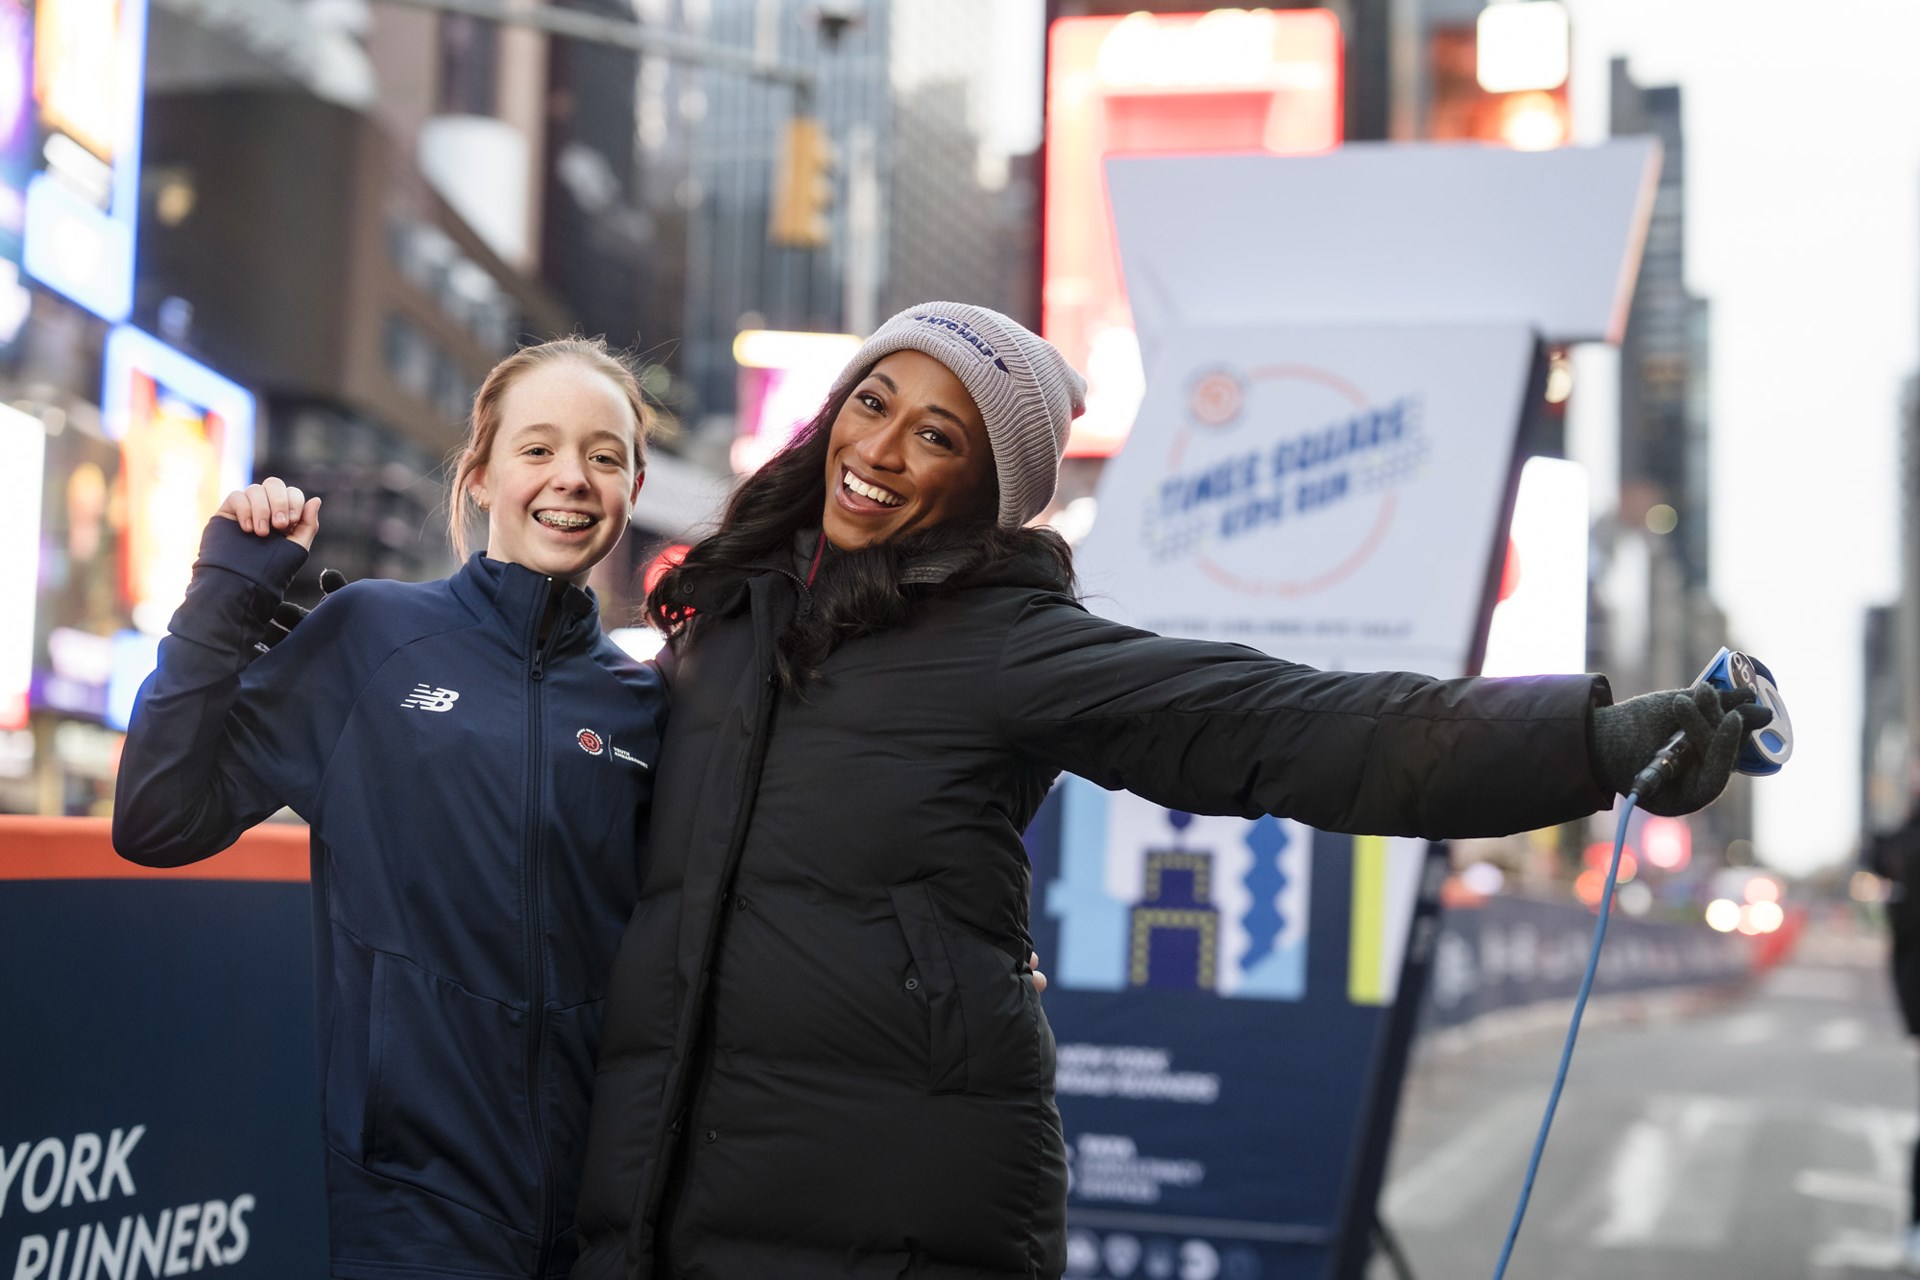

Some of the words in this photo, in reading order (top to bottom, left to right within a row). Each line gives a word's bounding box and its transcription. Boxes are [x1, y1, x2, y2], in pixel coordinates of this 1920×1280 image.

[927, 316, 958, 331] NYC
[956, 327, 994, 357] HALF
[1273, 396, 1406, 478] SQUARE
[0, 1124, 146, 1218] YORK
[13, 1194, 256, 1280] RUNNERS
